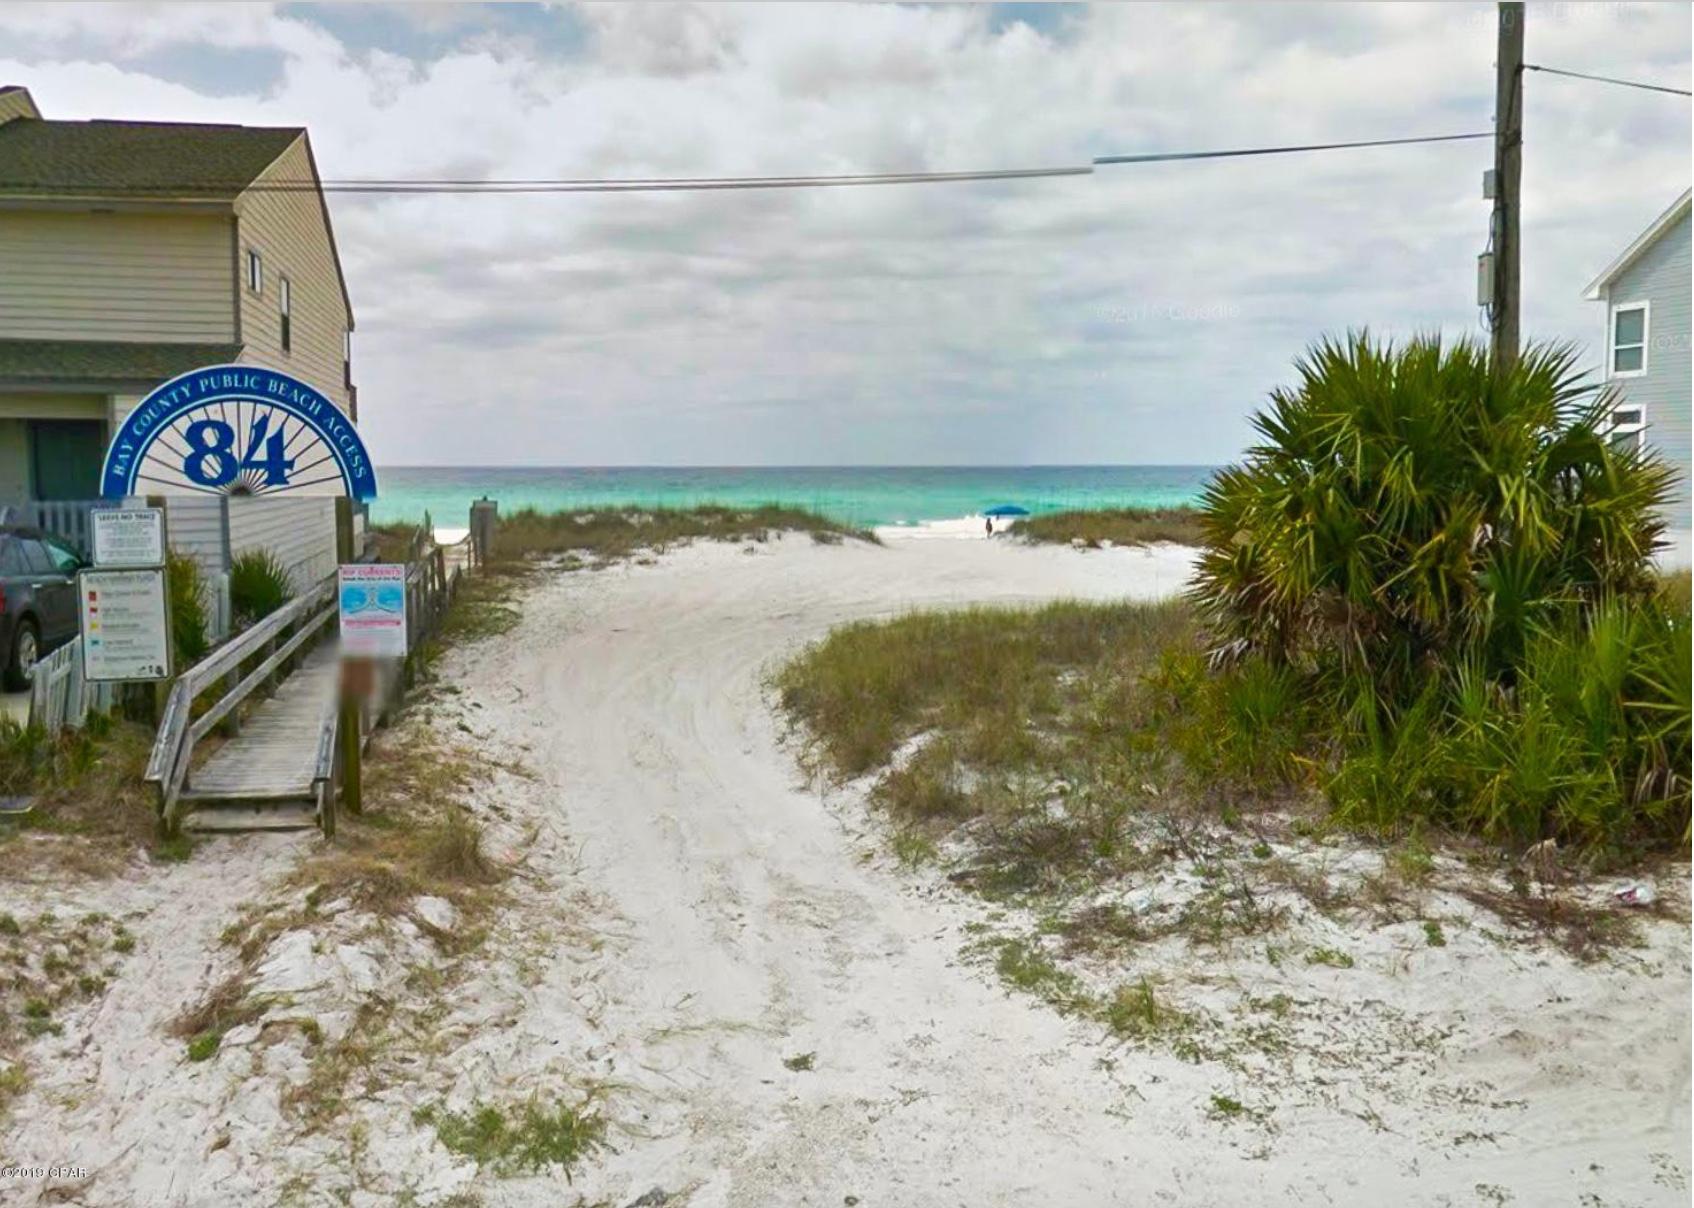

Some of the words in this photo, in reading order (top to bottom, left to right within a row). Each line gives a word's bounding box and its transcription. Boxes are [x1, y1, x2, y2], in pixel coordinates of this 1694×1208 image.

[112, 441, 134, 477] BAY
[132, 384, 192, 436] COUNTY
[199, 375, 261, 393] PUBLIC
[267, 379, 323, 414] BEACH
[325, 416, 367, 479] ACCESS
[183, 413, 296, 486] 84
